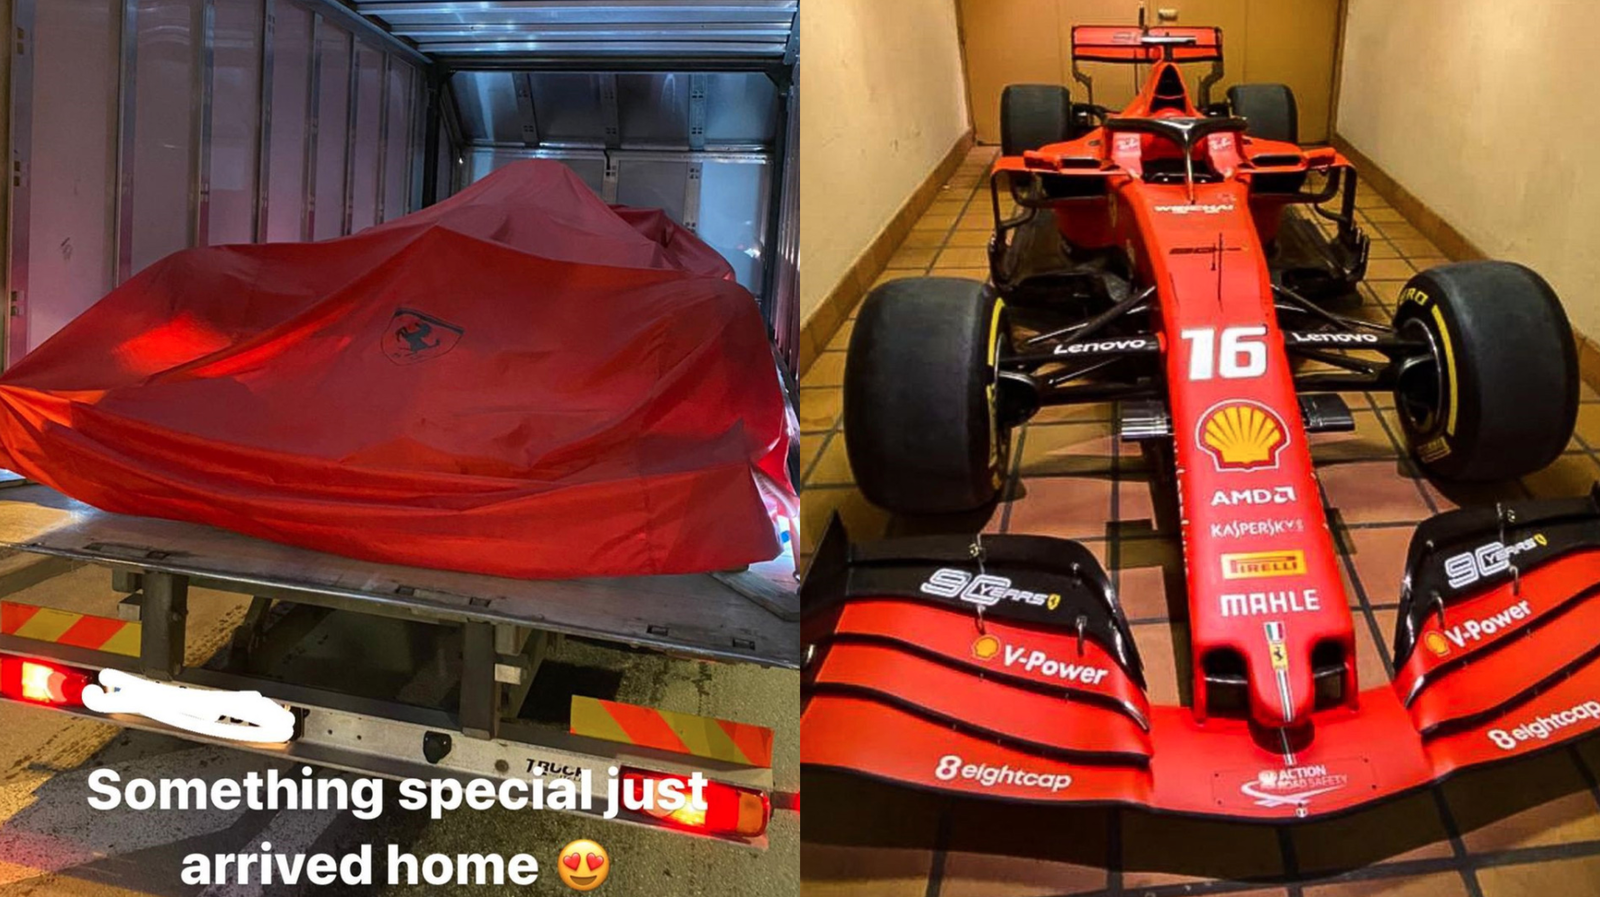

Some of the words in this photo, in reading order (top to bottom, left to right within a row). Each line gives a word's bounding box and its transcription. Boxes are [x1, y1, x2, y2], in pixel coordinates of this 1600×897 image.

[1053, 339, 1147, 354] Lenovo
[1292, 331, 1378, 344] Lenovo
[1181, 325, 1268, 380] 16
[1211, 489, 1272, 506] AMD
[1230, 555, 1298, 574] PIRELLI
[979, 583, 1048, 606] YEARS
[1220, 589, 1321, 617] MAHLE
[1444, 600, 1532, 648] V-Power
[1003, 645, 1109, 685] V-Power
[1279, 765, 1327, 781] ACTION
